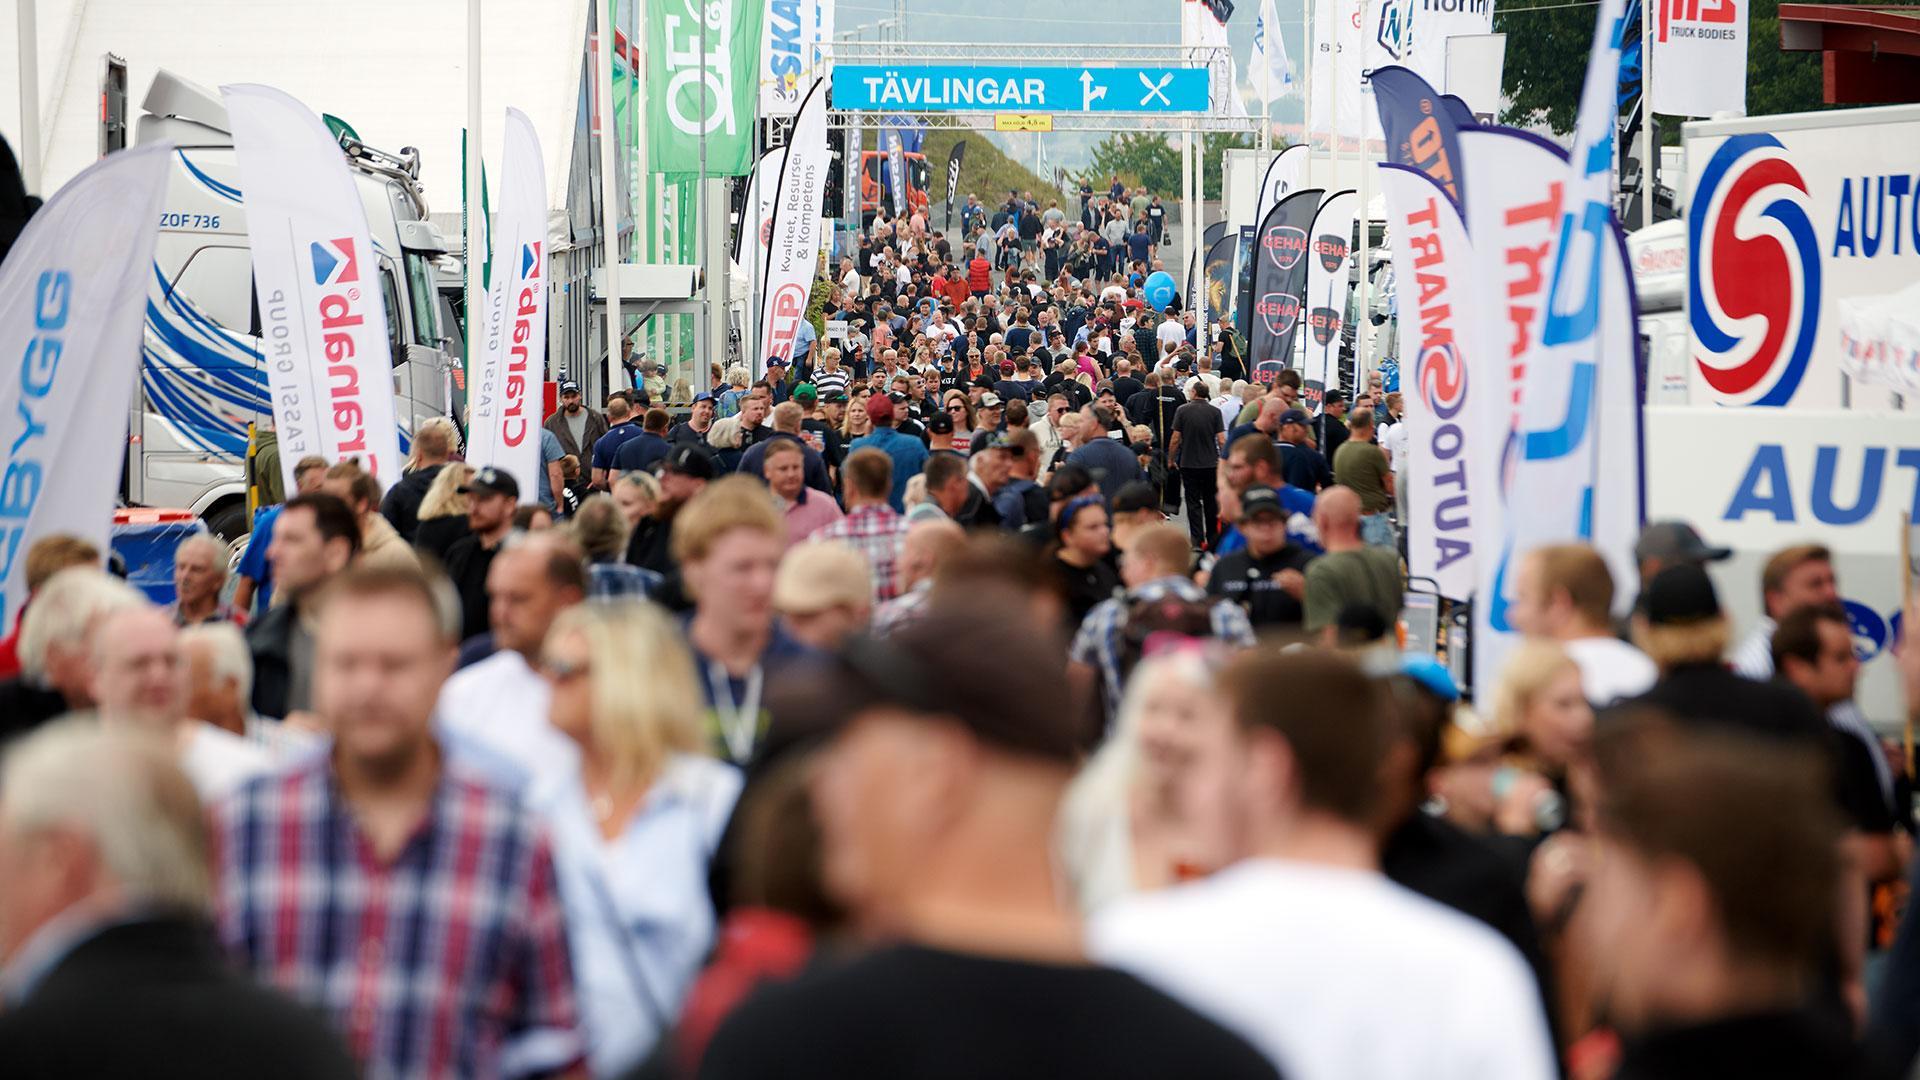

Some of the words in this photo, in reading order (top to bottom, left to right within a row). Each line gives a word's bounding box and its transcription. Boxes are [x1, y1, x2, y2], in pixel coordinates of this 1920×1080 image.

[1671, 26, 1696, 38] TRUCK
[1698, 28, 1736, 40] BODIES
[863, 72, 1045, 105] TÄVLINGAR
[797, 164, 816, 243] Kompetens
[159, 213, 190, 229] ZOF
[193, 214, 221, 230] 736
[780, 214, 797, 273] Kvalitet,
